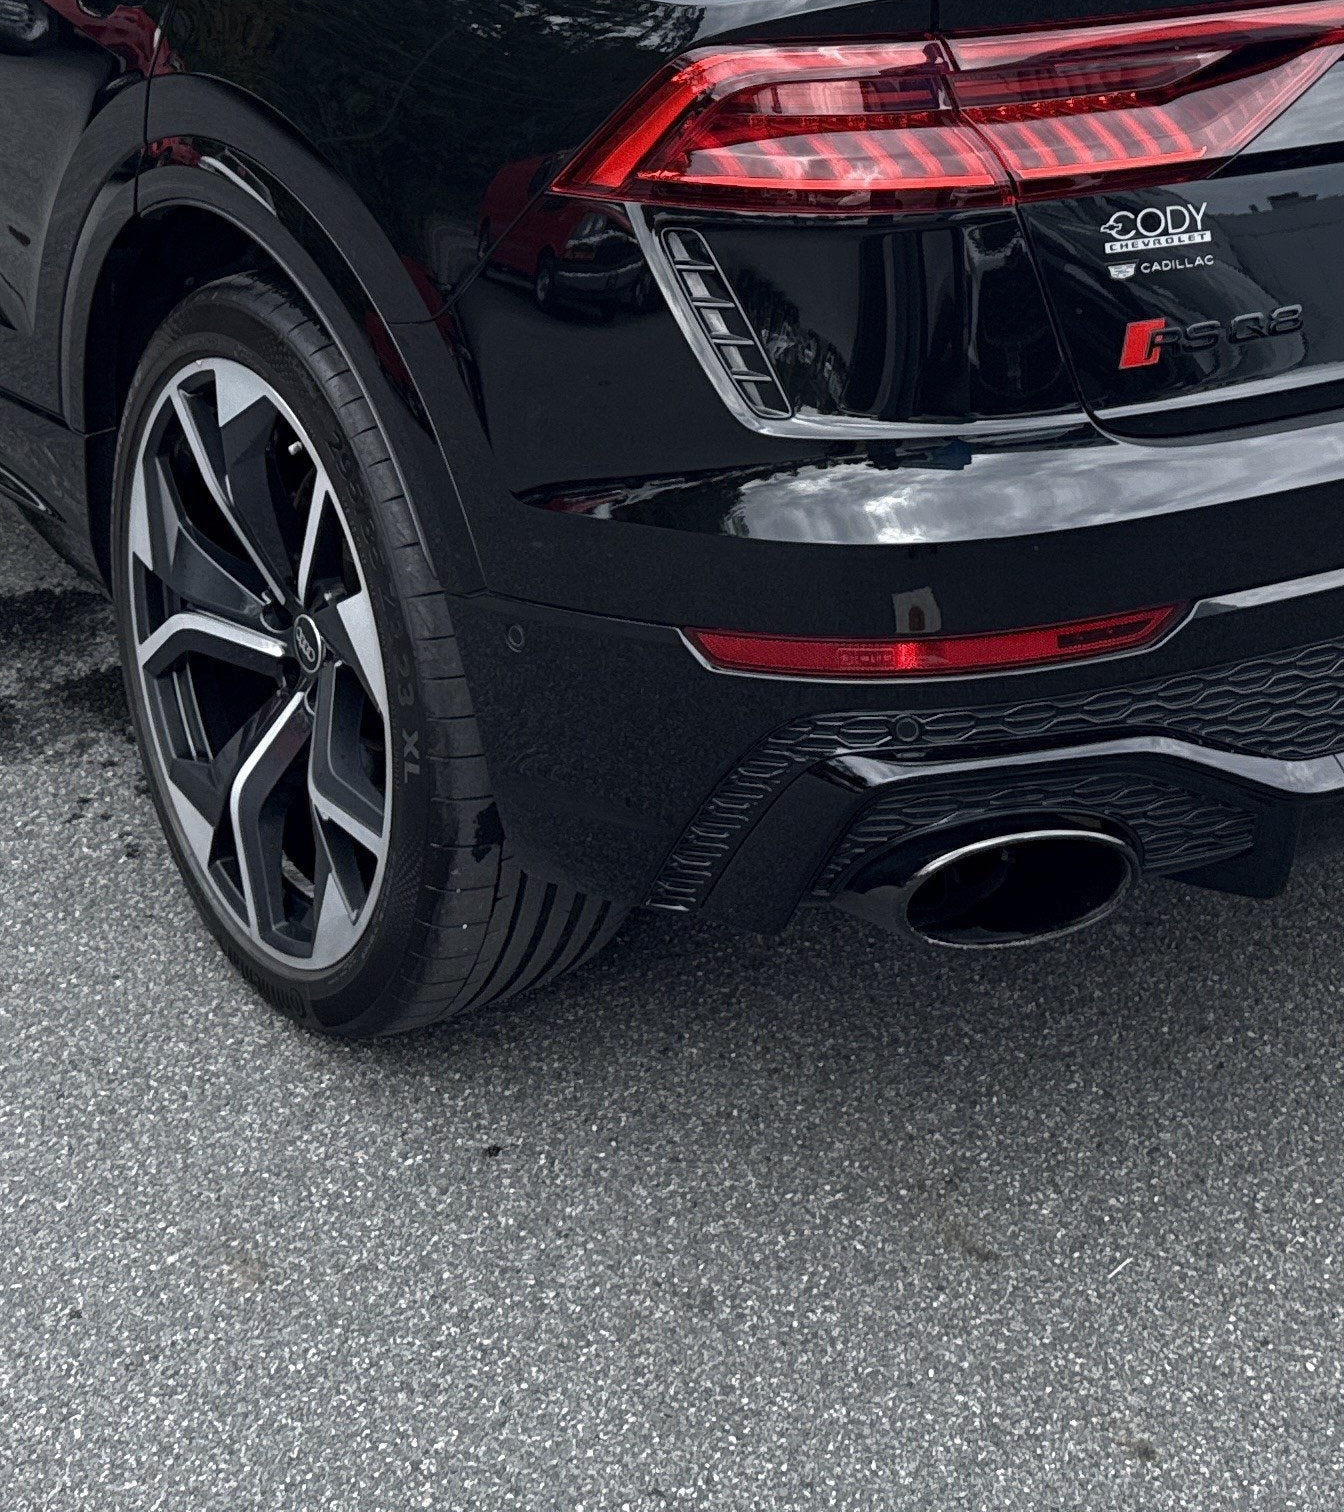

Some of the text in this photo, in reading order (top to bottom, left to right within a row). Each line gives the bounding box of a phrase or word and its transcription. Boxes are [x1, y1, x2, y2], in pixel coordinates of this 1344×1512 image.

[1101, 202, 1207, 239] CODY
[1109, 233, 1207, 252] CHEVROLET
[1140, 254, 1215, 273] CADILLAC
[402, 728, 421, 784] XL
